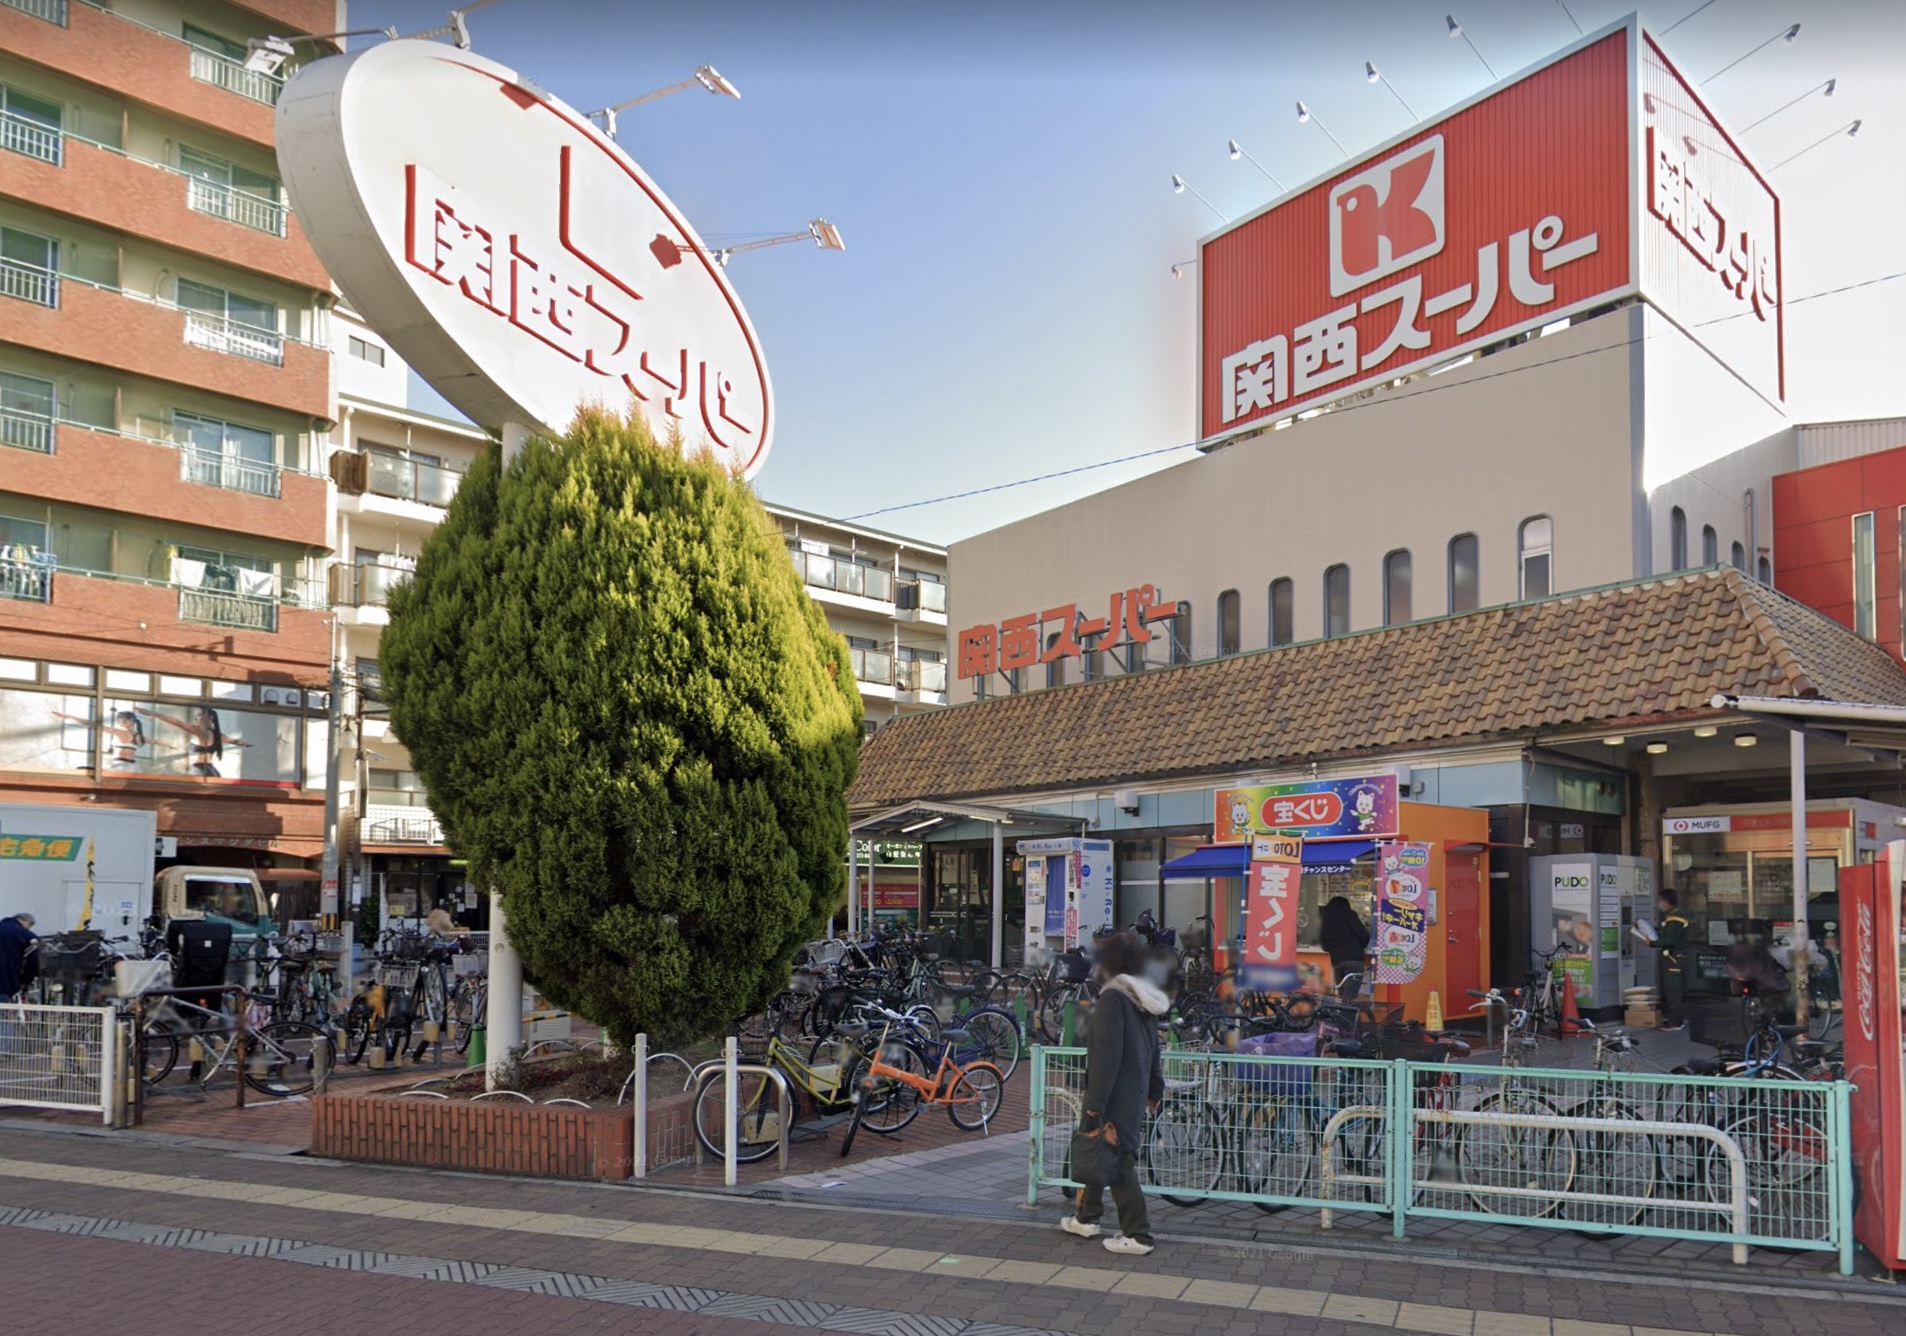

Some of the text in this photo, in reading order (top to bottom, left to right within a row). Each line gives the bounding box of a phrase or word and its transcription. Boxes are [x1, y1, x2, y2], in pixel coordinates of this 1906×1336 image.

[1222, 215, 1598, 424] 関西スーパー
[958, 583, 1178, 680] 関西スーパー
[1273, 798, 1329, 824] 宝くじ
[1691, 820, 1720, 829] MUFG
[1300, 865, 1351, 875] チャンスセンター
[1554, 876, 1589, 888] PUDO
